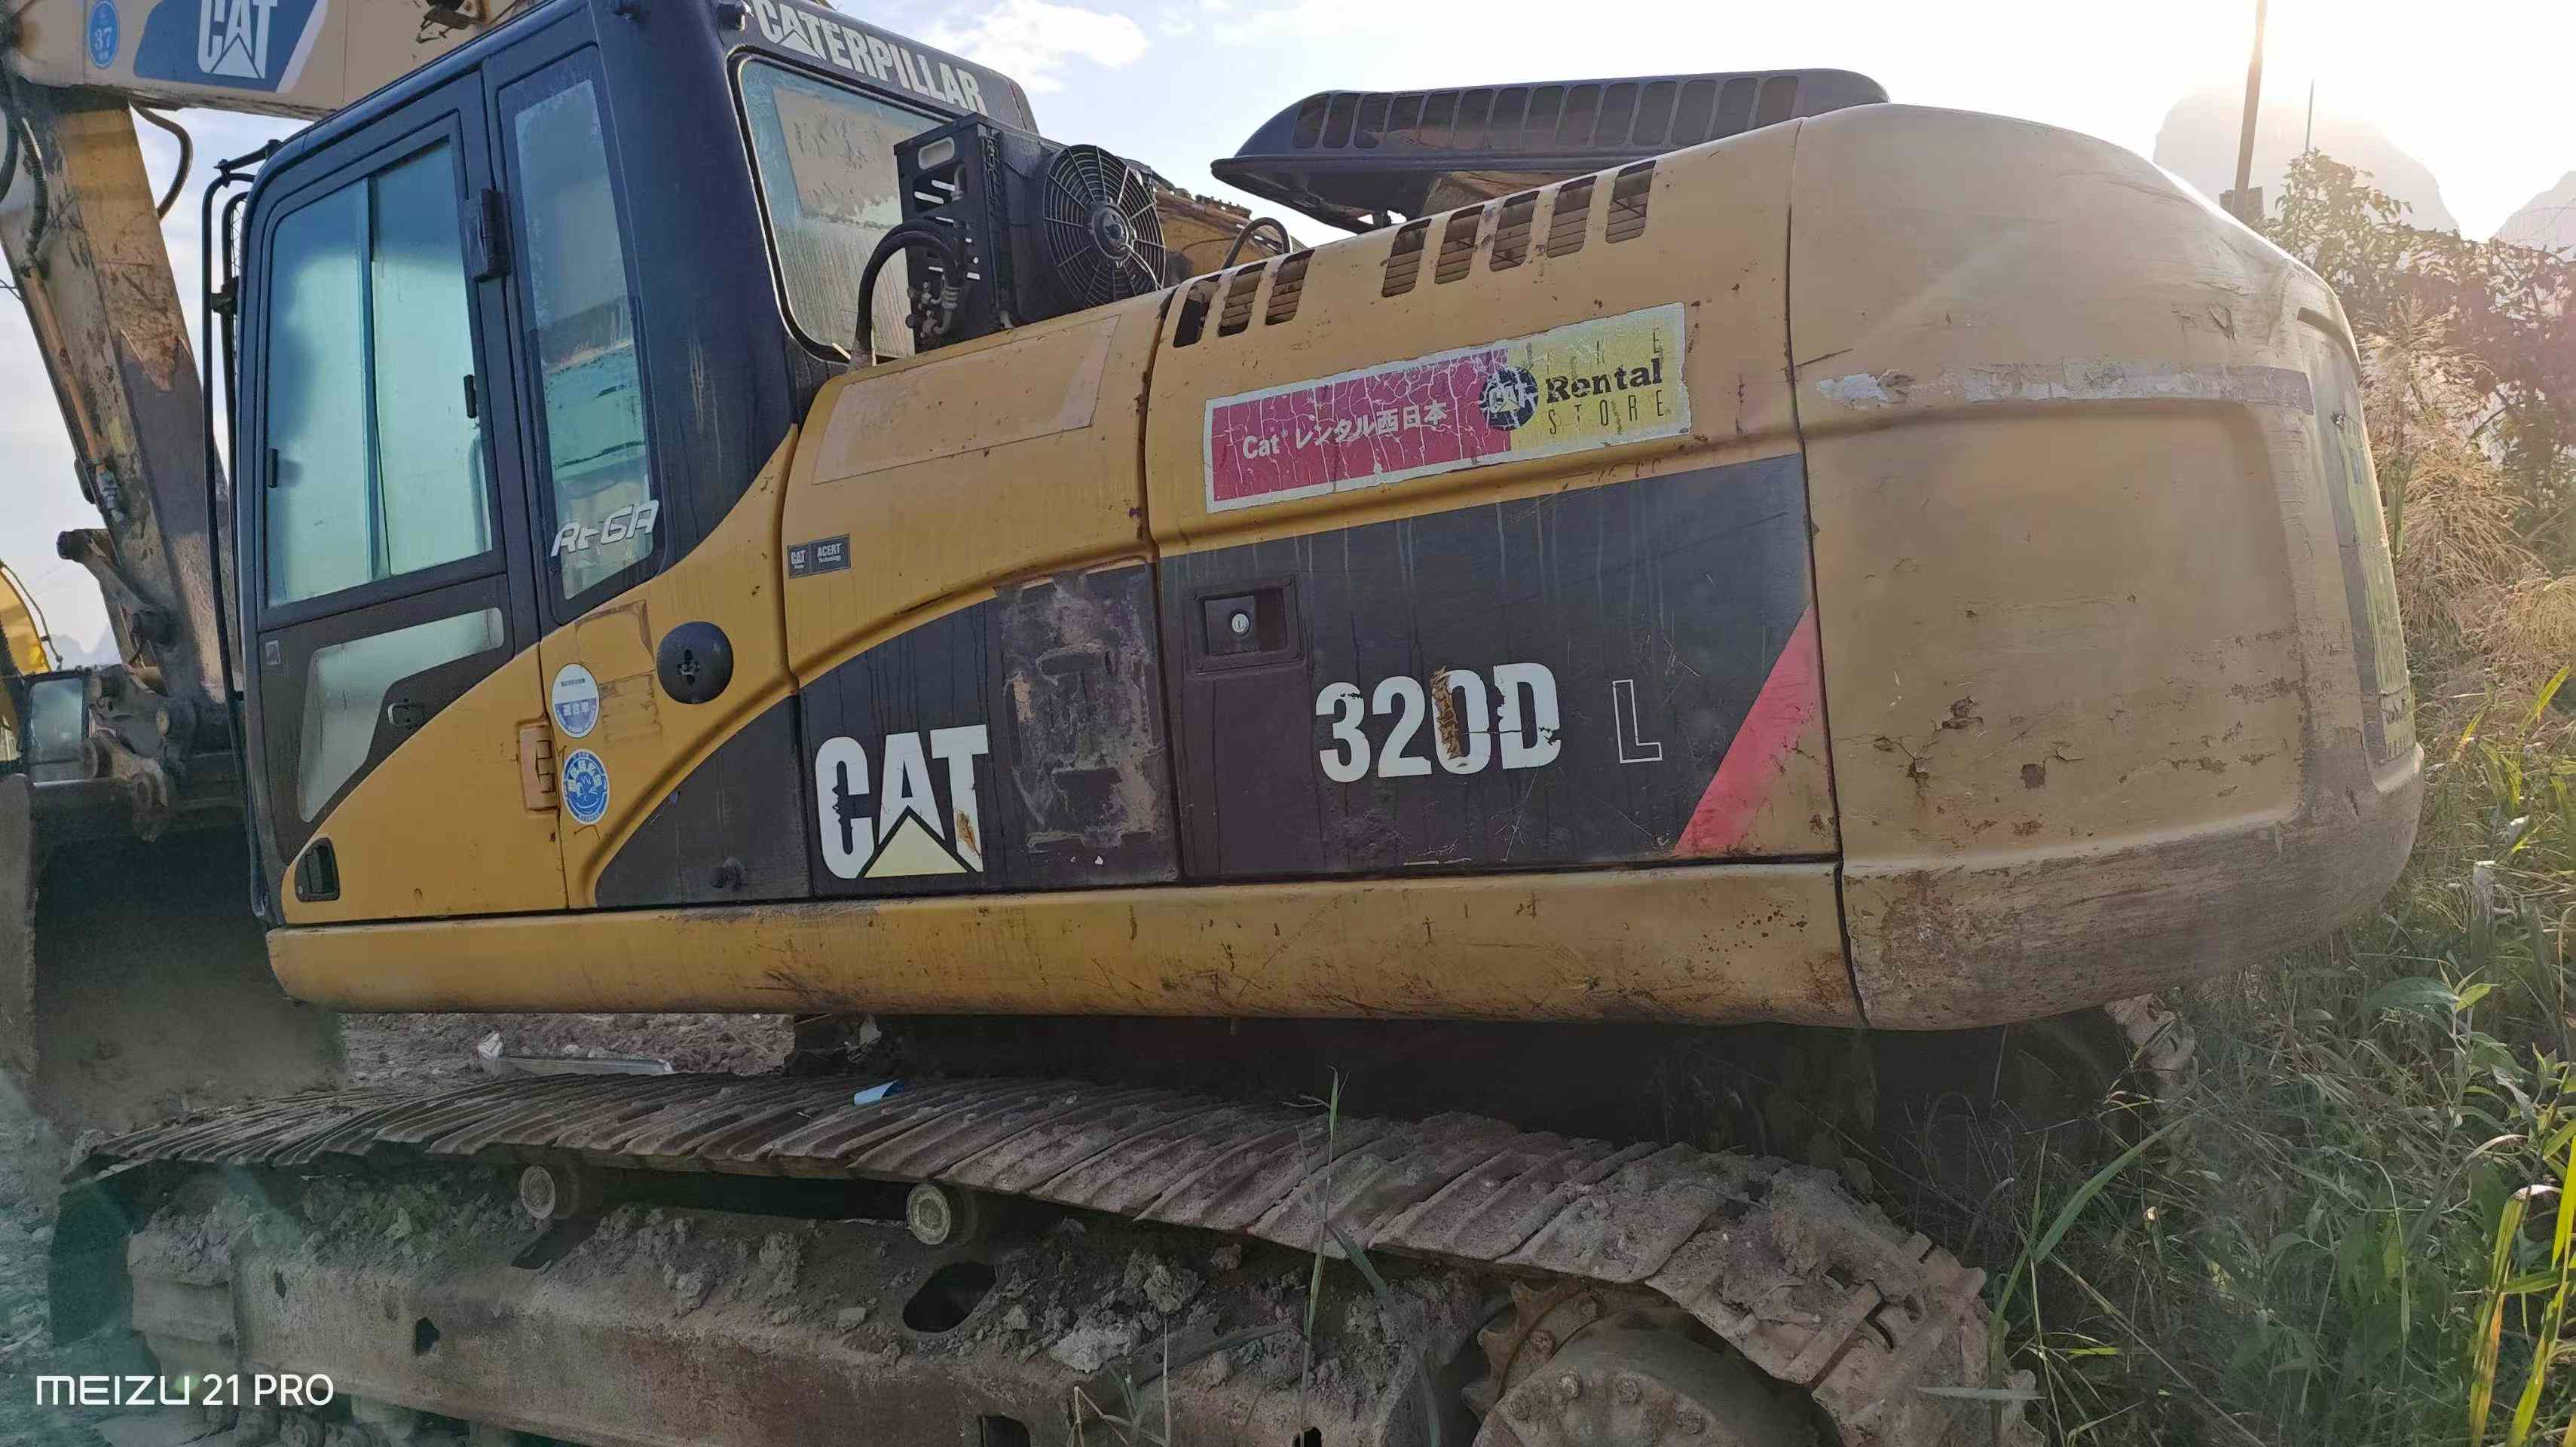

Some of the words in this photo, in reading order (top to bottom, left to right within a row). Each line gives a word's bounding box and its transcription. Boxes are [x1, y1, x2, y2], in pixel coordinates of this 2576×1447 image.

[197, 0, 277, 79] CAT
[754, 0, 988, 117] CATERPILLAR
[1546, 357, 1663, 404] Rental
[1549, 389, 1664, 436] STORE
[1243, 434, 1280, 458] Cat
[1296, 399, 1447, 449] レンタル西日本
[817, 543, 842, 558] ACERT
[1315, 662, 1562, 783] 320D
[1611, 679, 1663, 764] L
[815, 724, 989, 880] CAT
